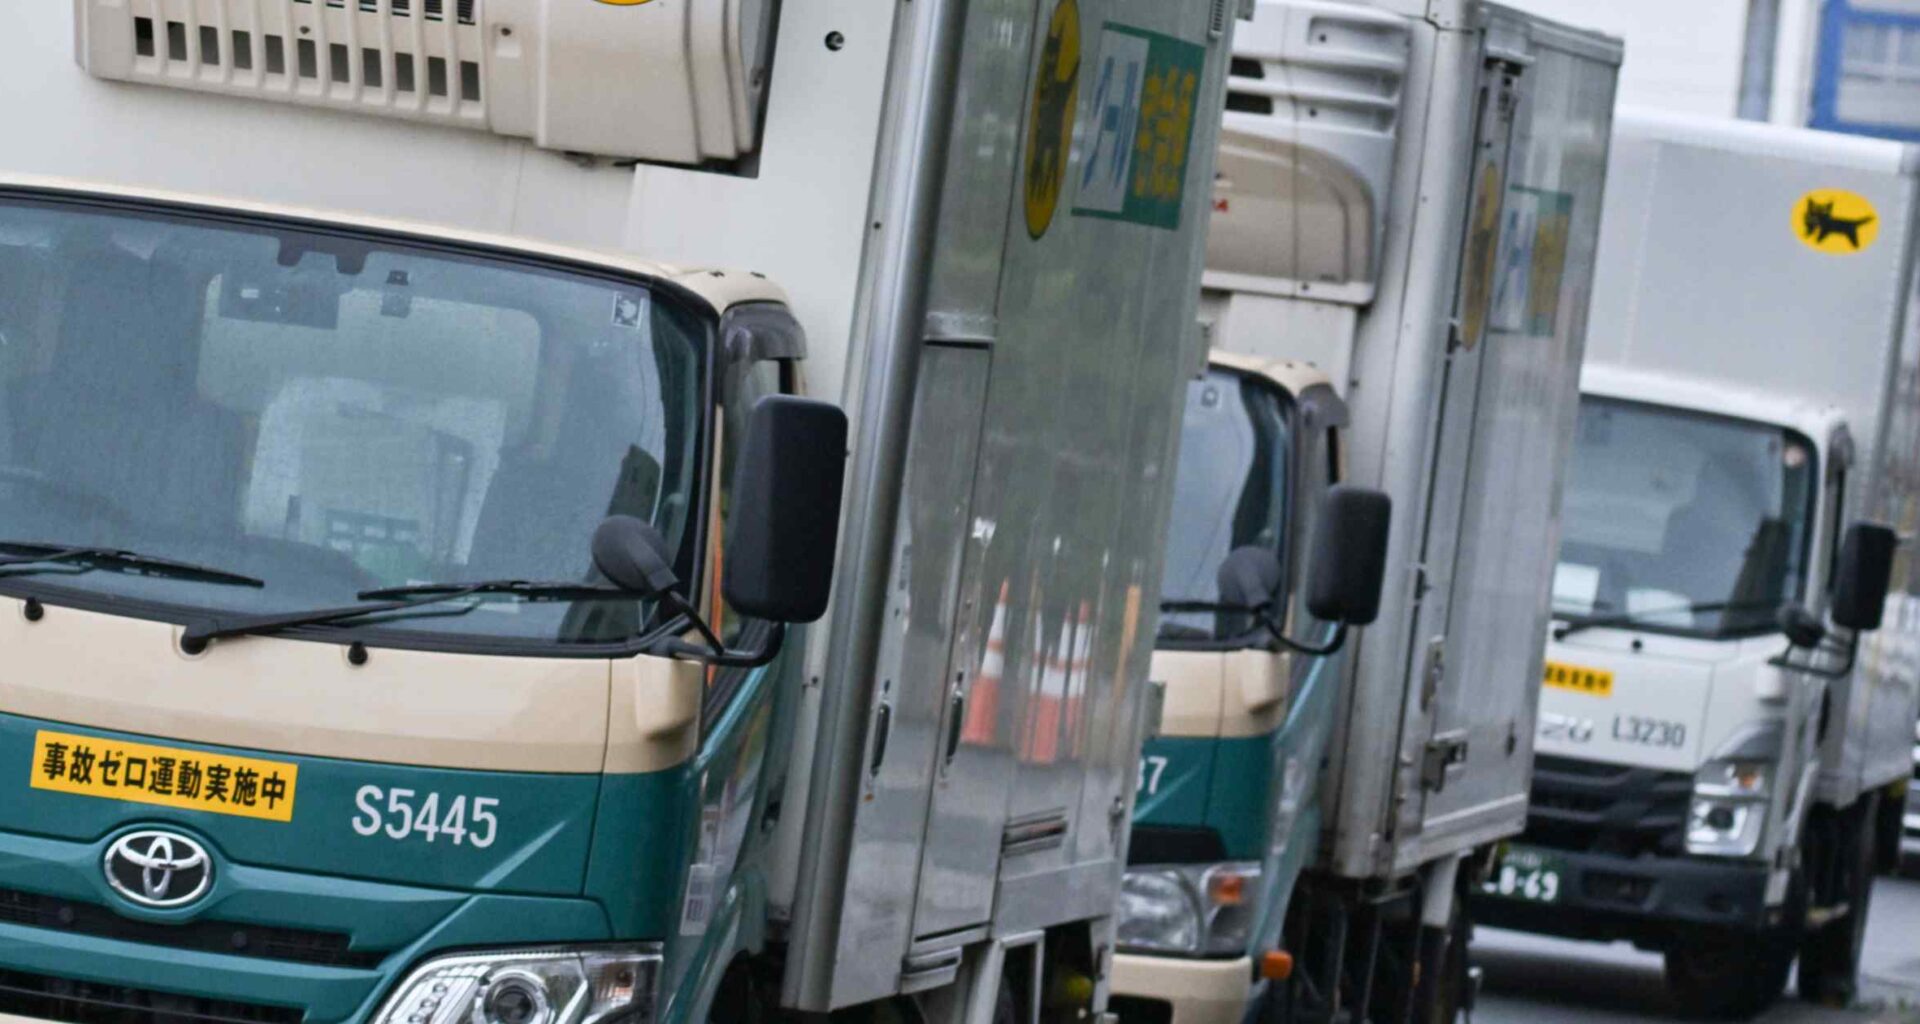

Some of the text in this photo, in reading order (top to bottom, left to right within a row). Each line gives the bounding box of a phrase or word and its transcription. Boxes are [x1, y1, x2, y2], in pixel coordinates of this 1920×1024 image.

[1612, 713, 1687, 748] L3230
[42, 741, 287, 810] 事故ゼロ運動実施中
[352, 784, 500, 848] S5445
